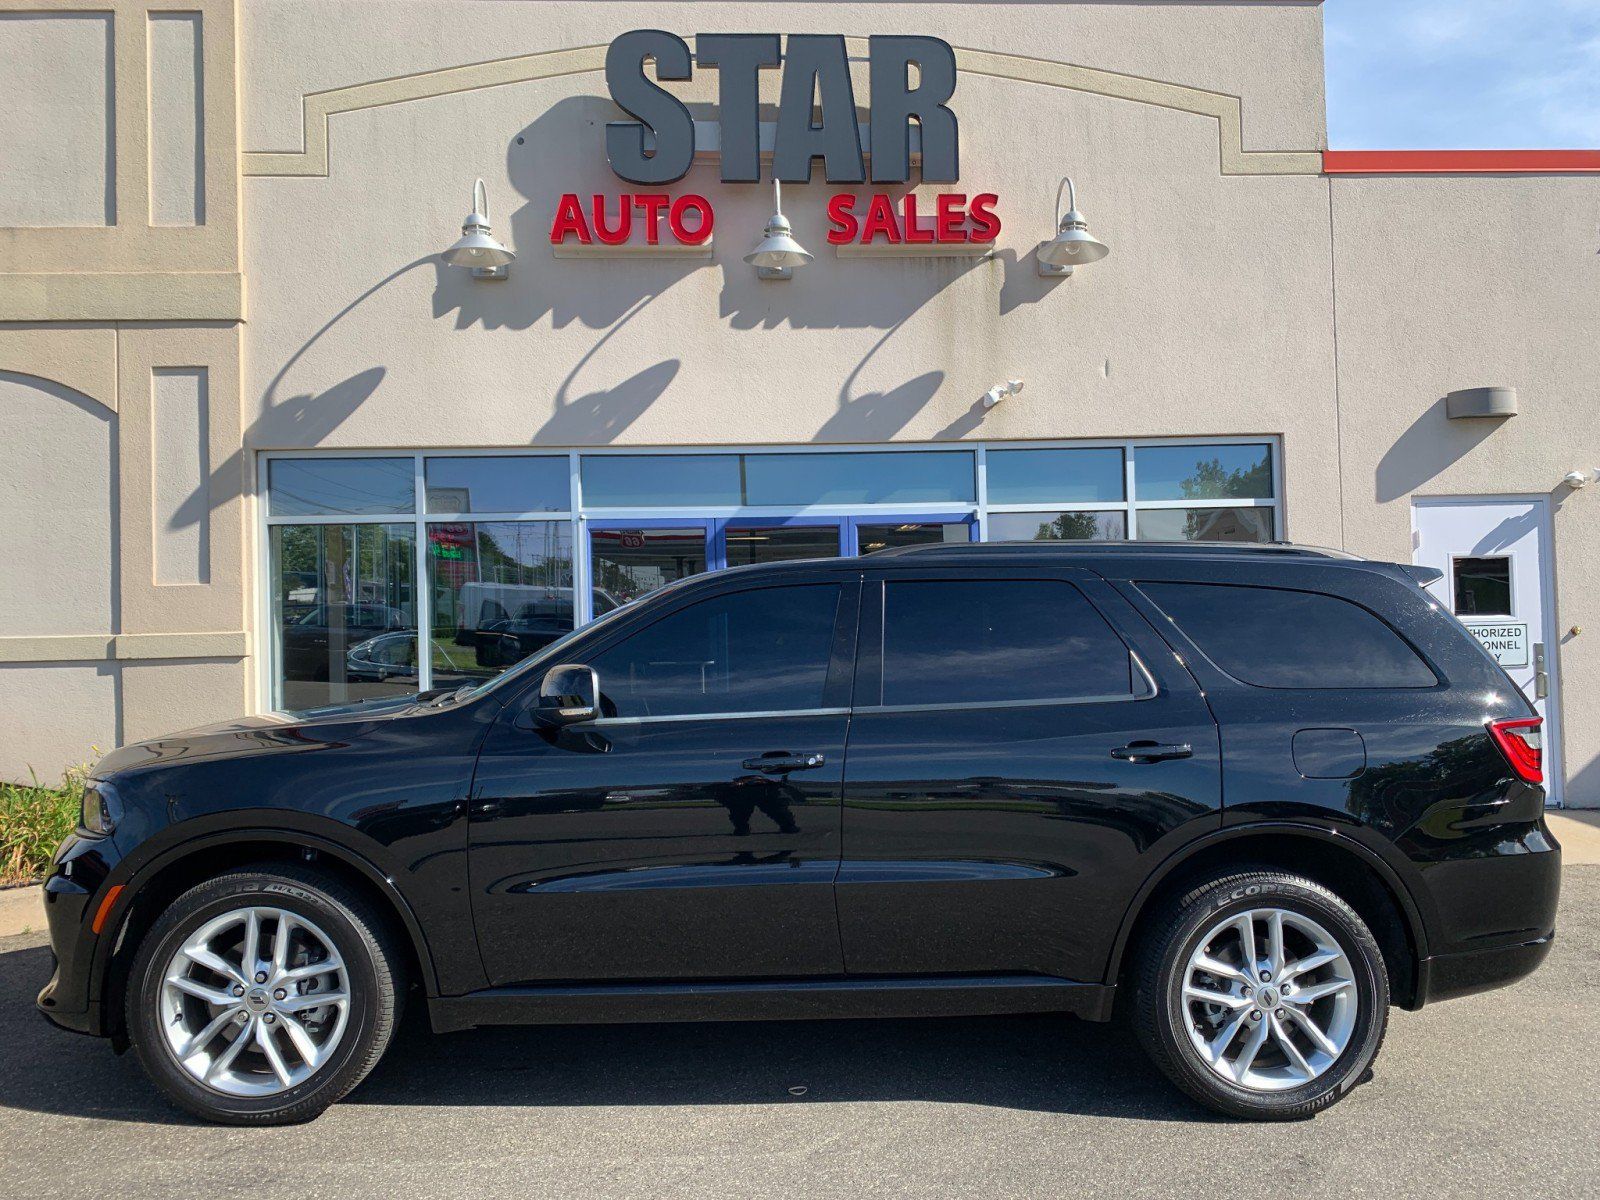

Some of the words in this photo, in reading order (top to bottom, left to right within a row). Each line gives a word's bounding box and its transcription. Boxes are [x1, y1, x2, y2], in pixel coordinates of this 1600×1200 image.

[605, 29, 959, 185] STAR
[550, 193, 714, 246] AUTO
[826, 193, 1002, 245] SALES
[1470, 628, 1521, 637] HORIZED
[1482, 641, 1520, 649] ONNEL
